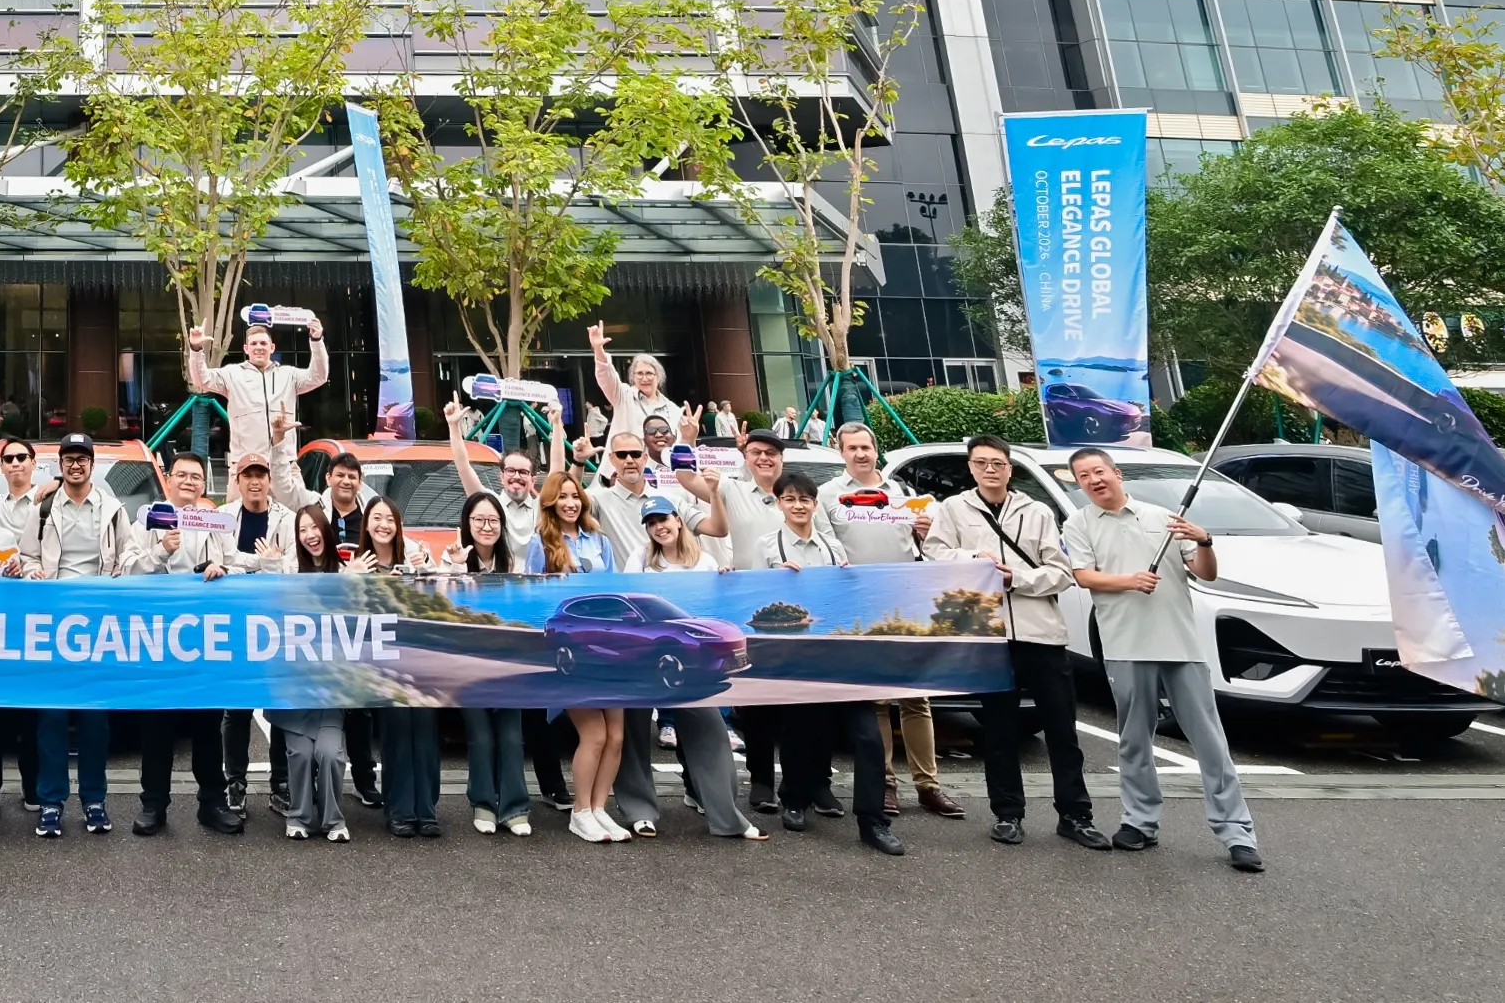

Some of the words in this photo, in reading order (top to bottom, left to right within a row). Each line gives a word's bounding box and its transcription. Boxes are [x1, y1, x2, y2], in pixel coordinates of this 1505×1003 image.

[1026, 135, 1122, 149] Lepas
[1035, 170, 1050, 233] OCTOBER
[1060, 170, 1083, 274] ELEGANCE
[1090, 169, 1111, 232] LEPAS
[1038, 234, 1051, 260] 2026
[1039, 272, 1051, 312] CHINA
[1090, 236, 1112, 319] GLOBAL
[1061, 279, 1083, 341] DRIVE
[1459, 474, 1496, 501] Drive
[847, 511, 866, 521] Drive
[246, 613, 401, 661] DRIVE
[1375, 658, 1402, 668] Lep
